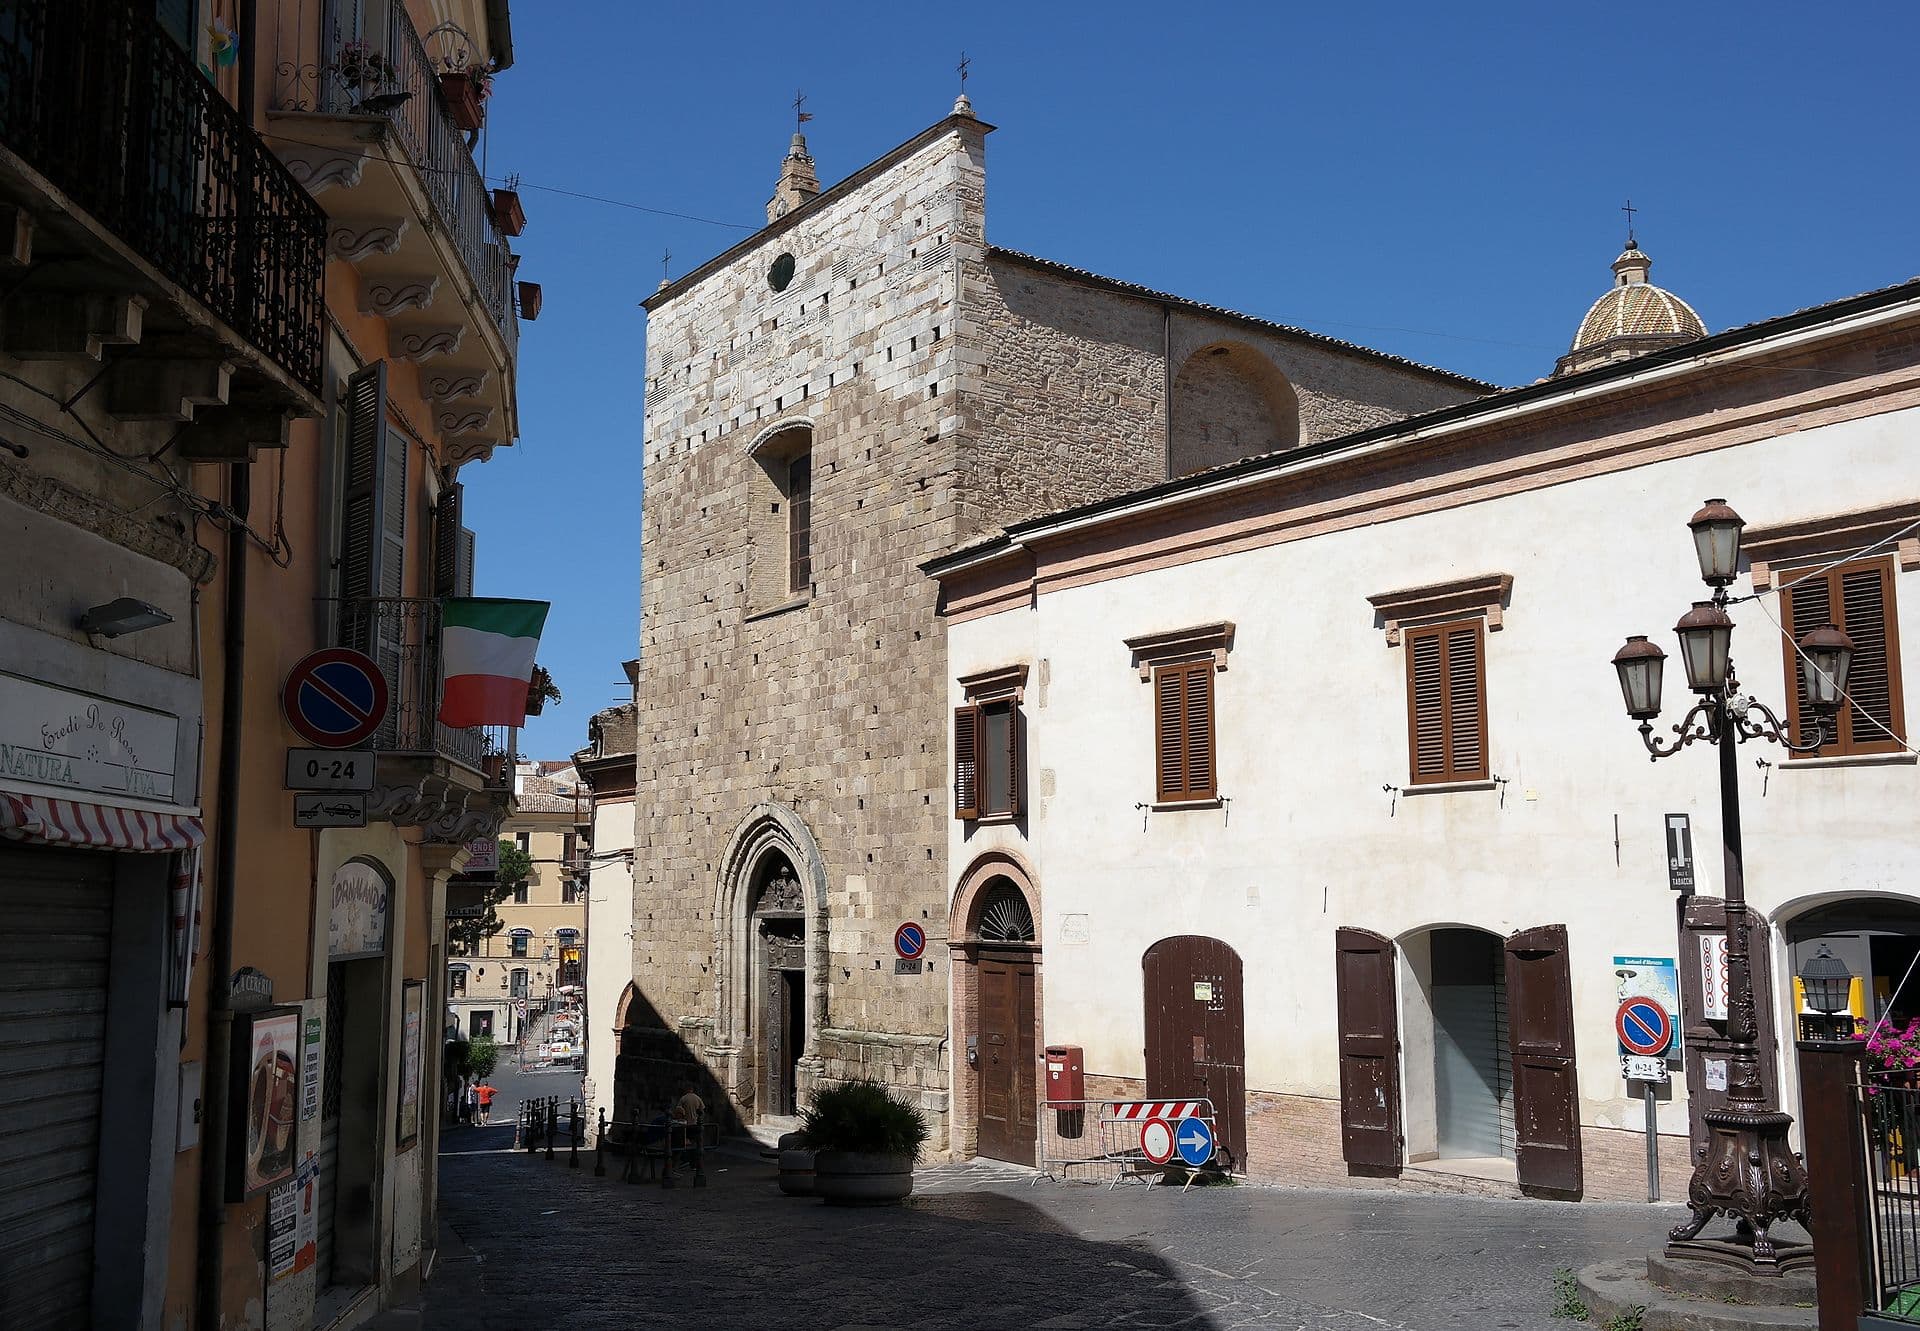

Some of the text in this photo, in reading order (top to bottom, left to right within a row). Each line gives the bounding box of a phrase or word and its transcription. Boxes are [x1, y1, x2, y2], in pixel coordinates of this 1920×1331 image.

[41, 703, 140, 766] Eredi De Rosa
[0, 743, 157, 796] NATURA VIVA
[306, 759, 355, 779] 0-24
[1635, 1062, 1653, 1073] 0-24
